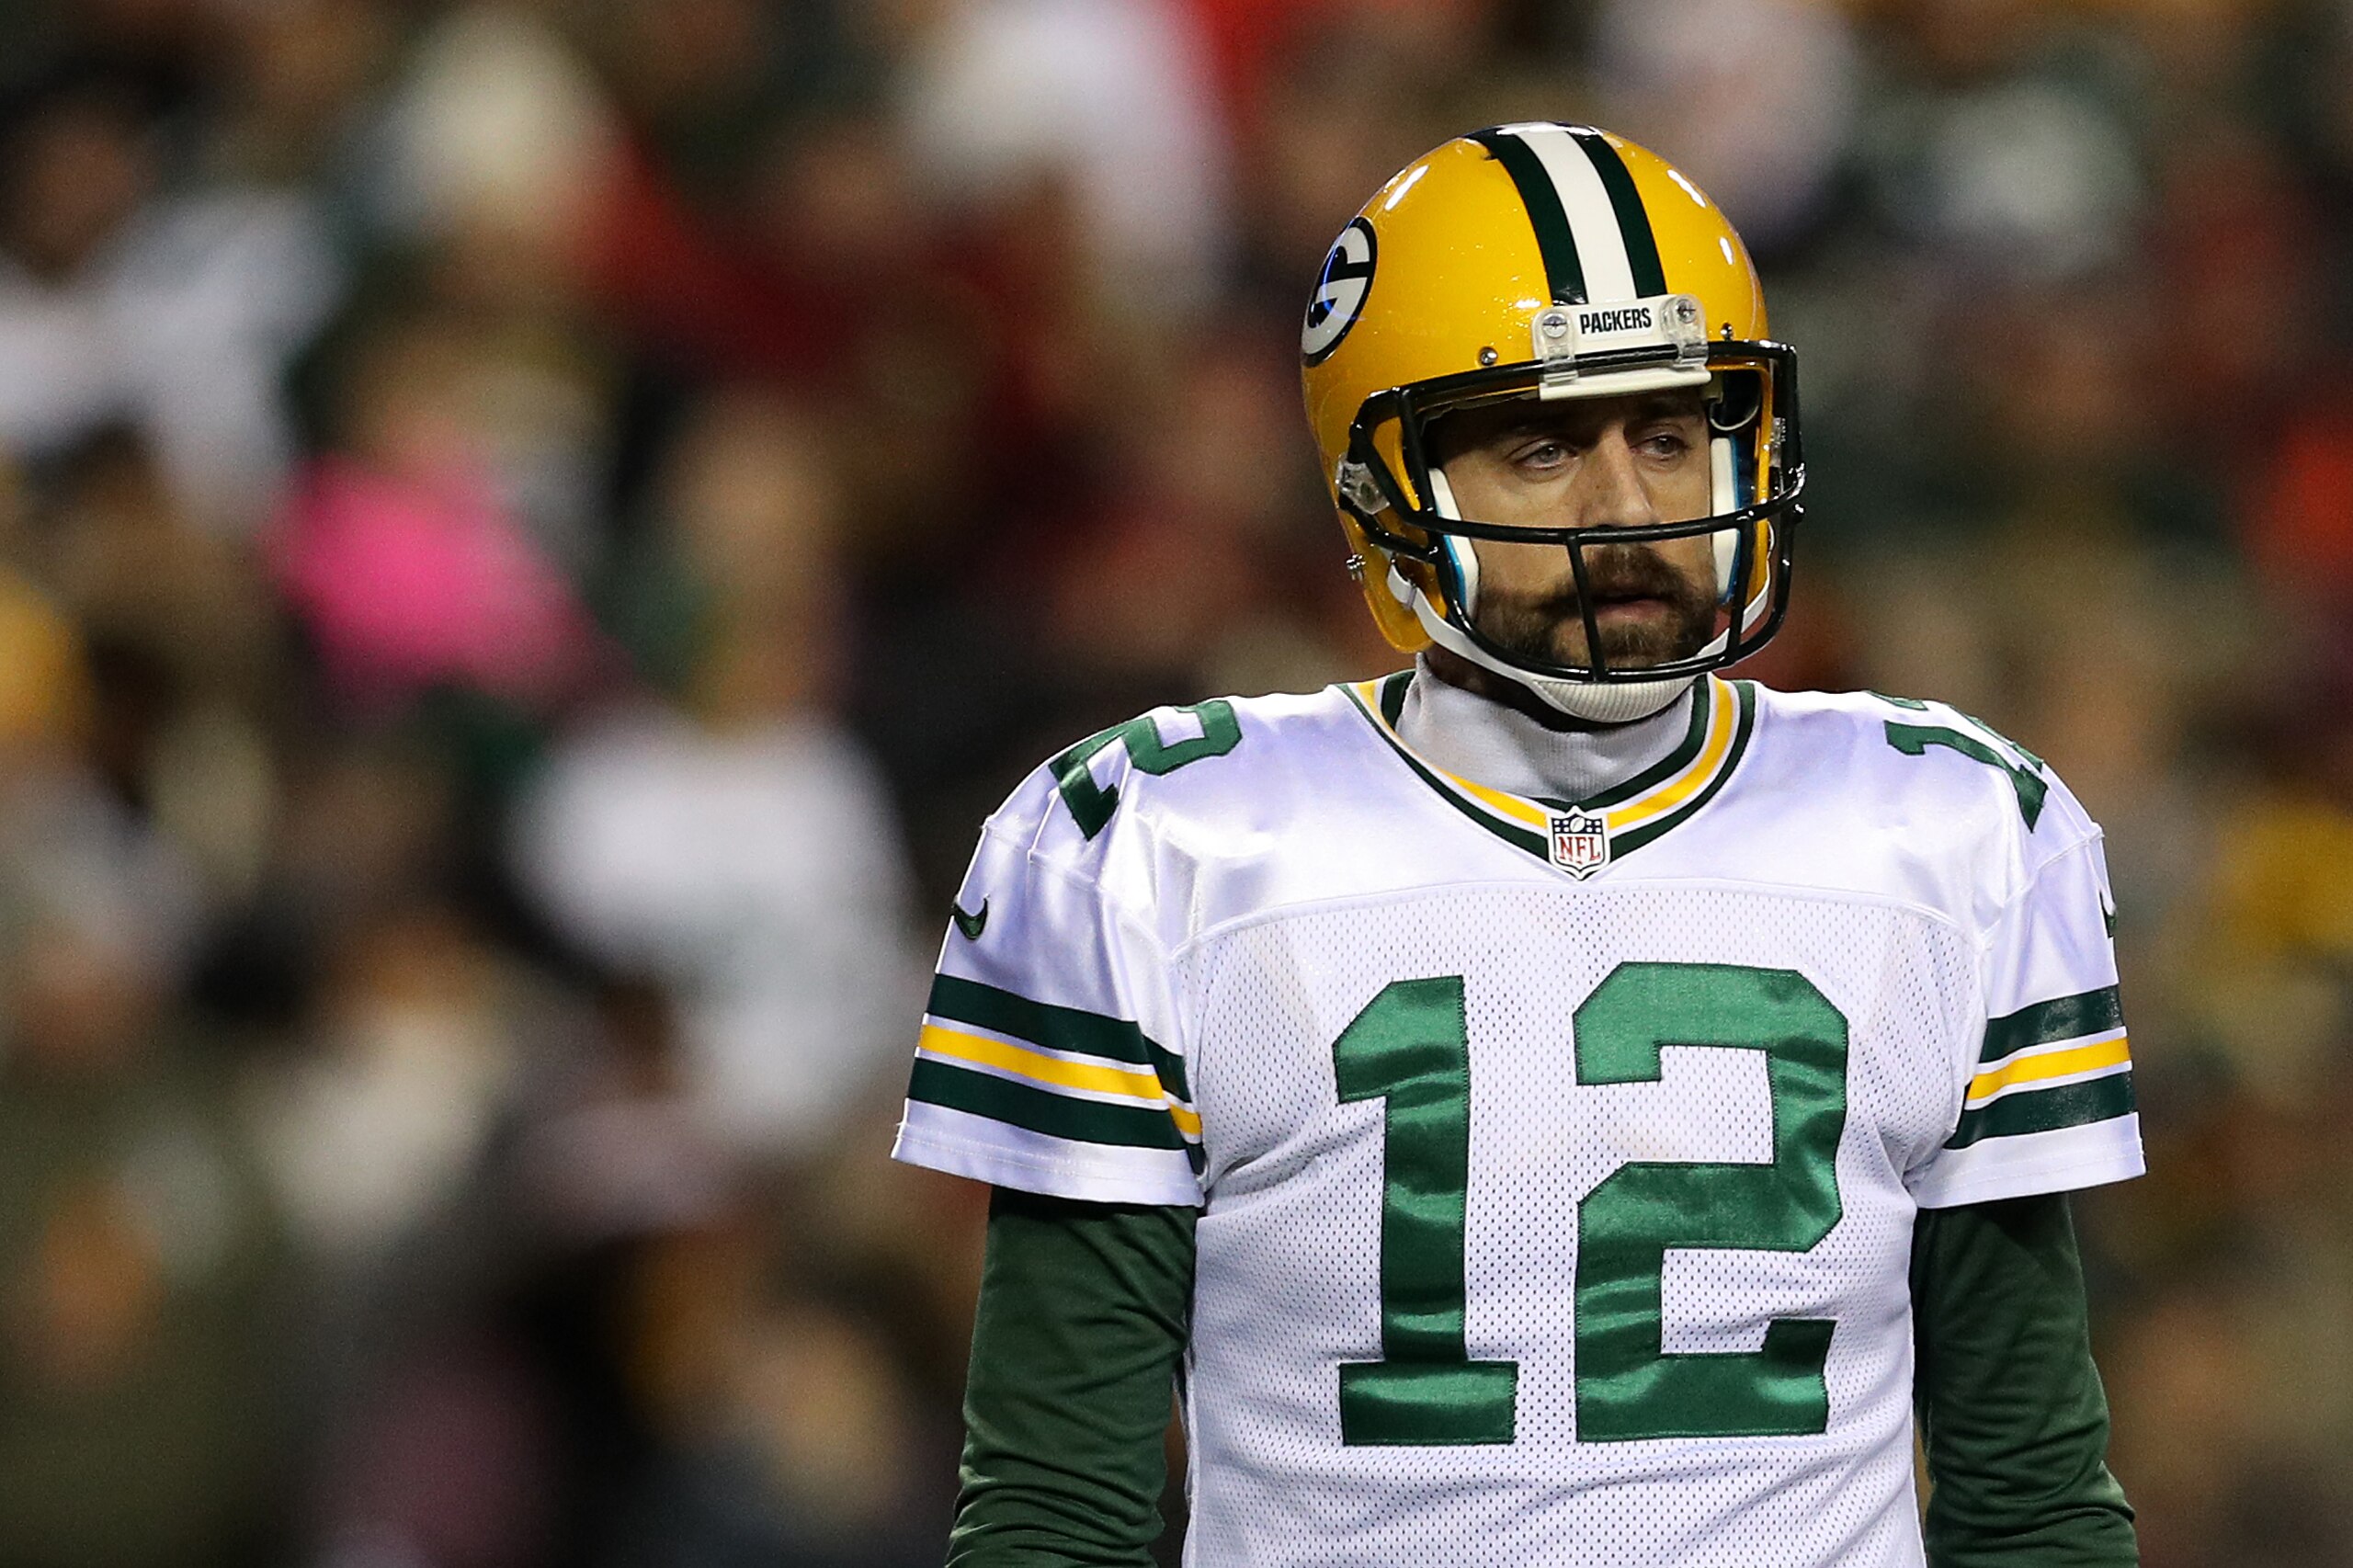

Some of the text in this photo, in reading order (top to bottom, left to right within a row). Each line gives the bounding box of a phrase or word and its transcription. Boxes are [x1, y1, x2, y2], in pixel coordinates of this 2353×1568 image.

[1579, 307, 1653, 335] PACKERS
[1558, 835, 1601, 865] NFL
[1333, 961, 1849, 1447] 12
